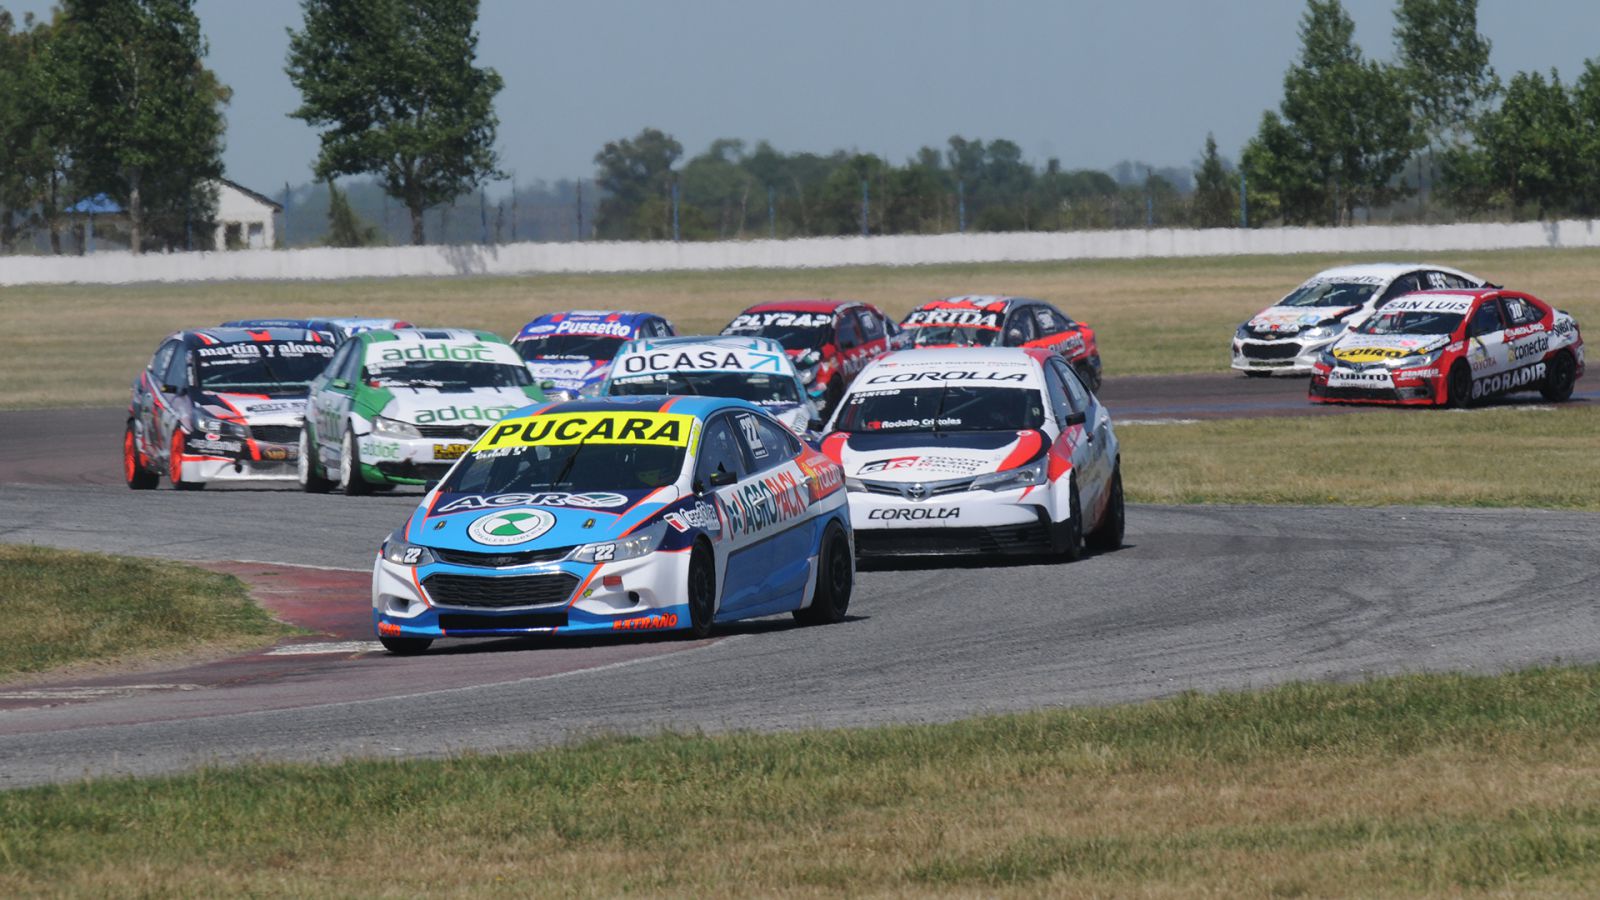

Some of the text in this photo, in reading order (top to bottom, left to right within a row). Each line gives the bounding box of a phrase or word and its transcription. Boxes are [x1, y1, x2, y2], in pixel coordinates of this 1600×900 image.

[1384, 300, 1467, 310] SAN LUIS
[907, 311, 999, 328] FRIDA
[555, 320, 631, 336] Pussetto
[278, 342, 334, 355] alonso
[382, 343, 496, 361] addoc
[1514, 336, 1550, 361] conectar
[624, 351, 744, 373] OCASA
[866, 371, 1028, 385] COROLLA
[1482, 362, 1547, 396] CORADIR
[487, 417, 680, 446] PUCARA
[881, 419, 920, 429] Rodolfo
[868, 507, 960, 521] COROLLA
[403, 548, 423, 564] 22
[594, 543, 617, 564] 22
